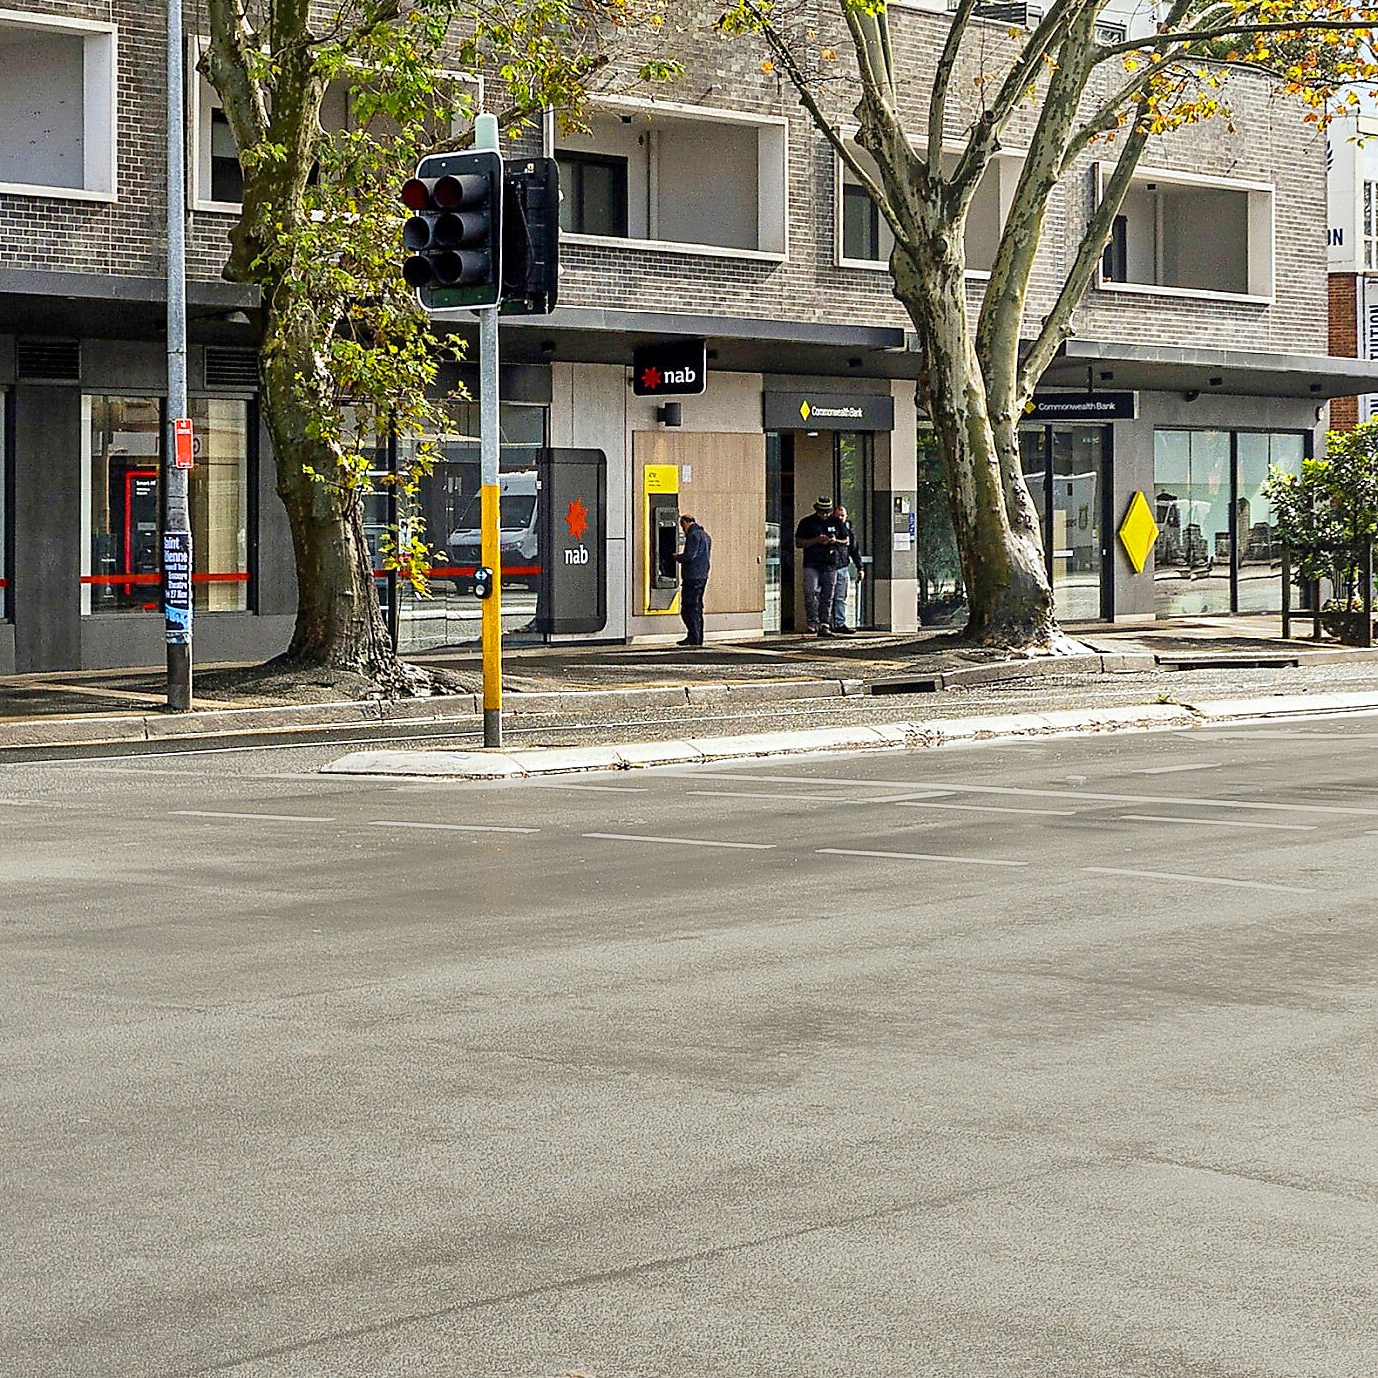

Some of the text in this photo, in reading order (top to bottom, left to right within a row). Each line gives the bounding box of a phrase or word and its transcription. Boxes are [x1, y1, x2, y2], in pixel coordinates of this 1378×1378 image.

[664, 367, 696, 384] nab
[164, 550, 188, 563] tienne
[564, 544, 589, 565] nab
